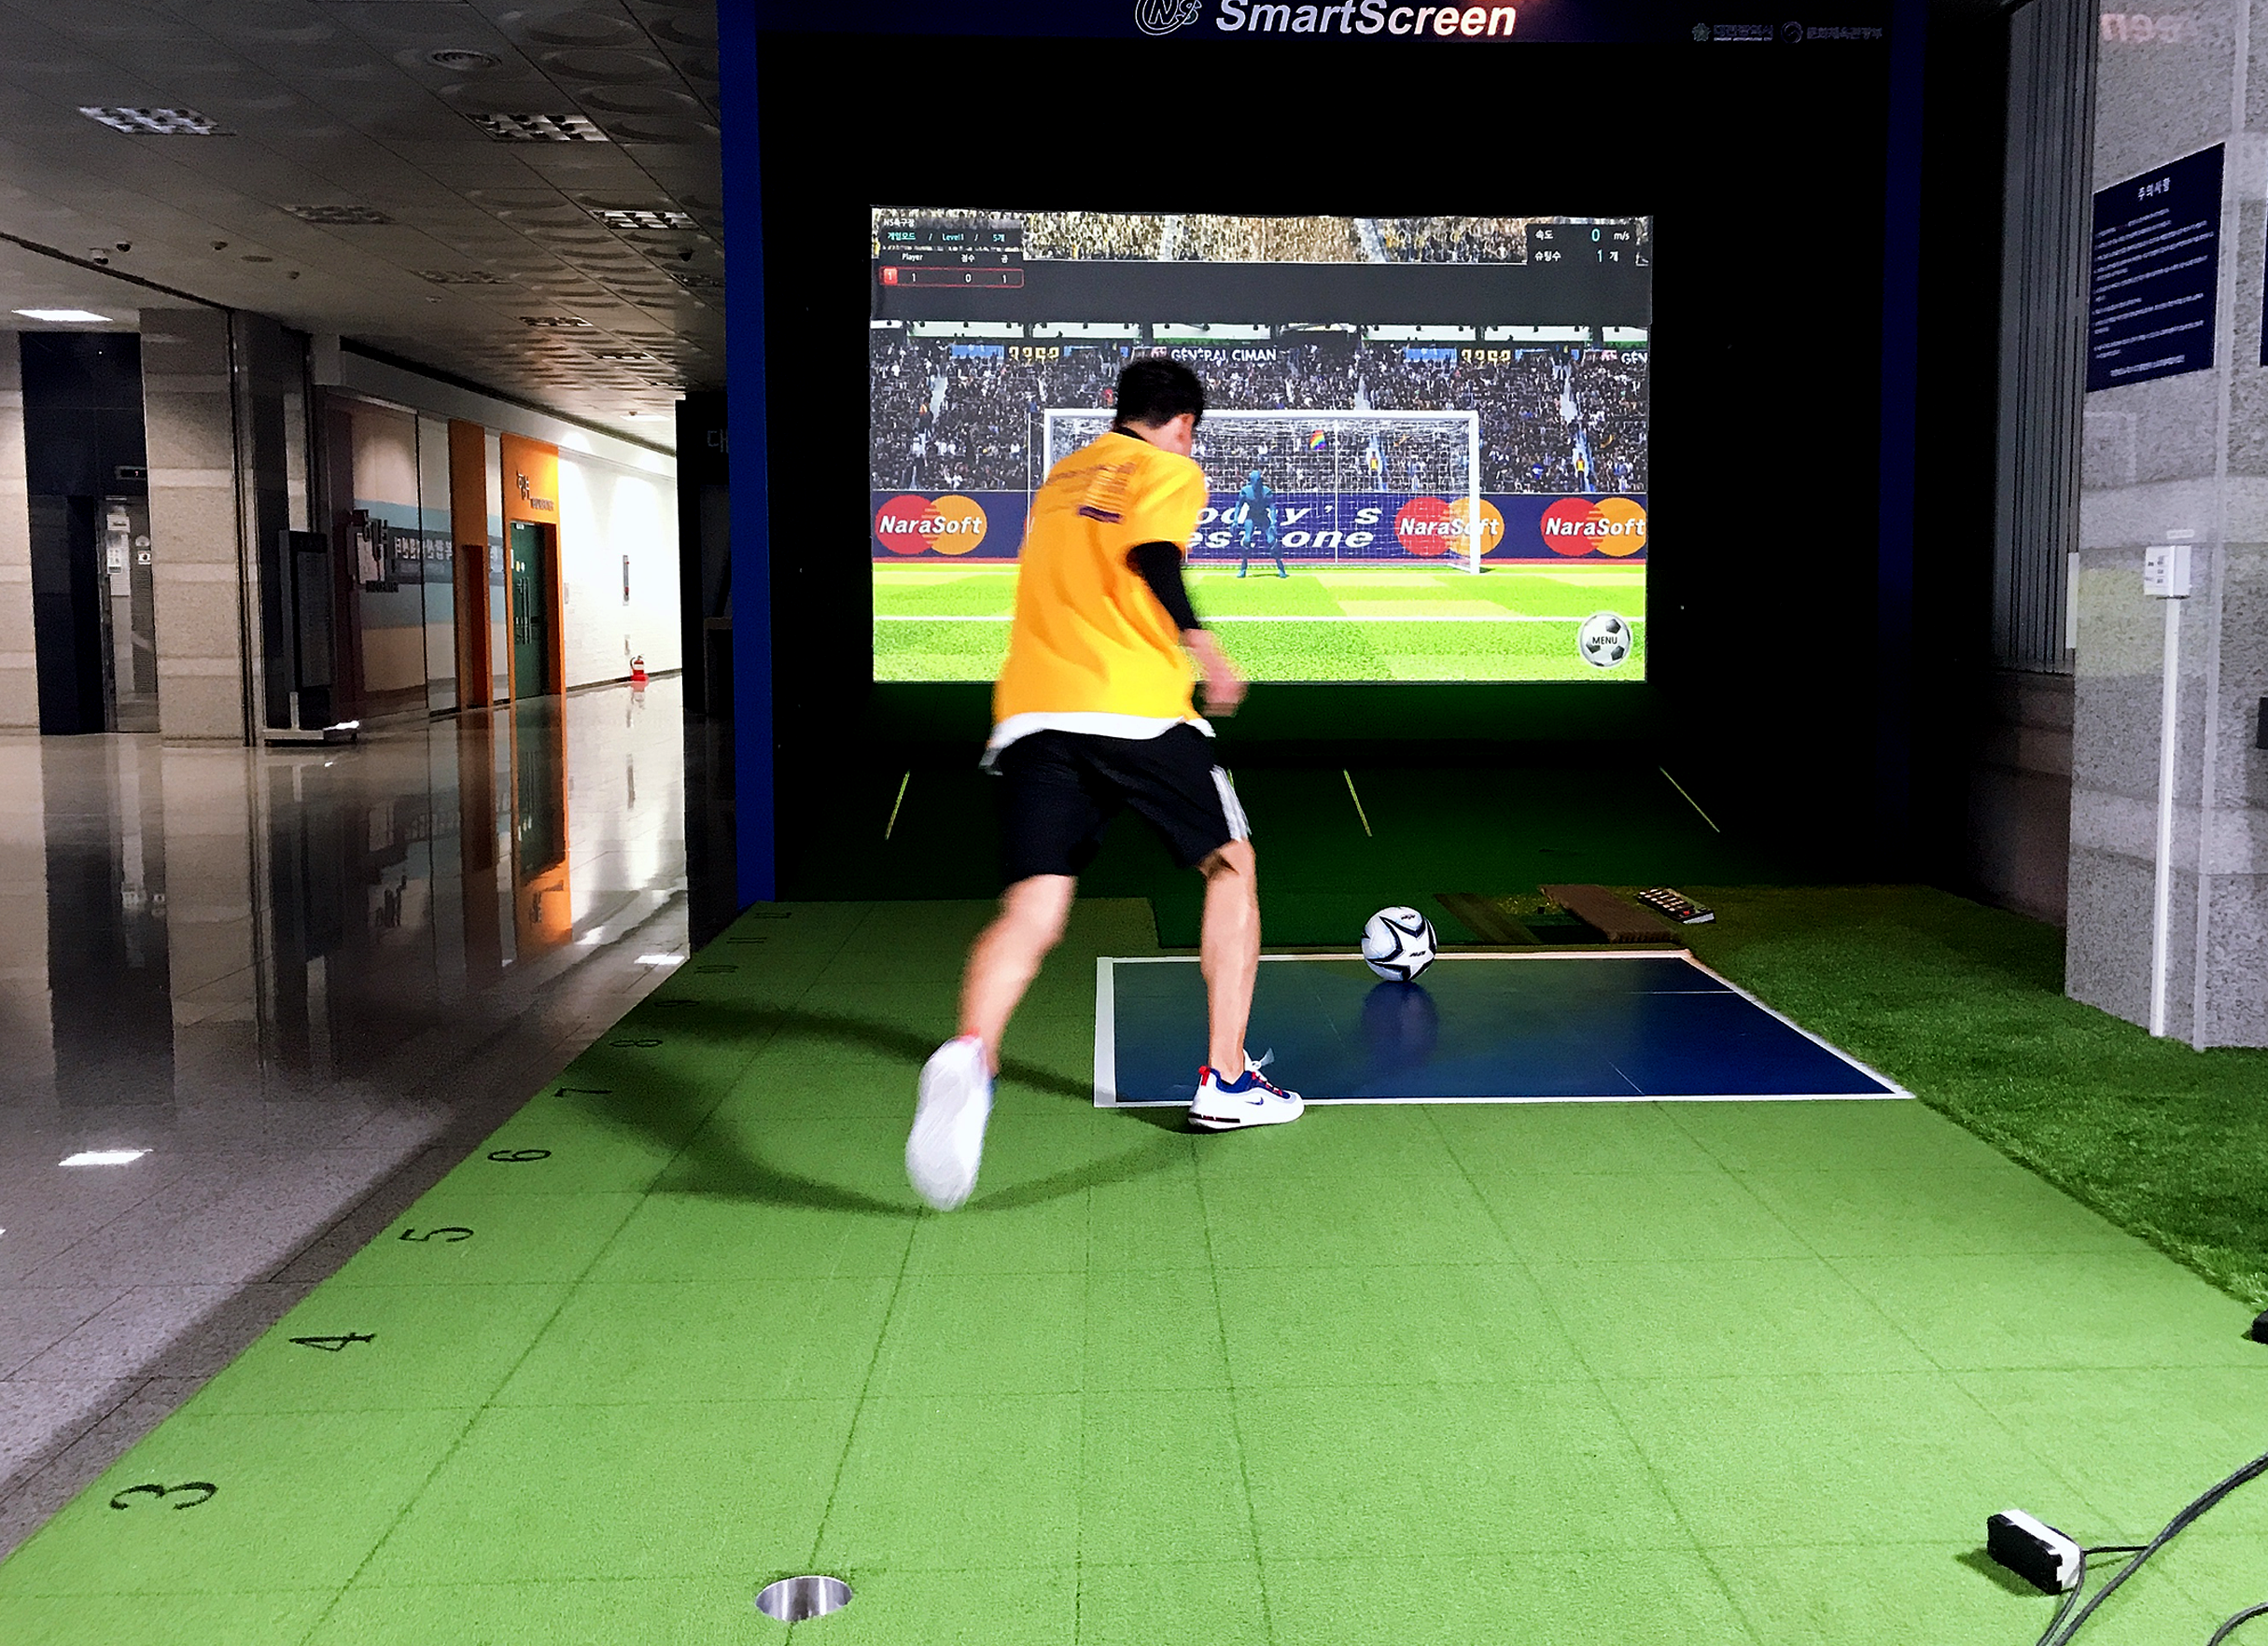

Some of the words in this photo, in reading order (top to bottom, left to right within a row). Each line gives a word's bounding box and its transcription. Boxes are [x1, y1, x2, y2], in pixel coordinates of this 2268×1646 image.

[1215, 0, 1517, 36] SmartScreen
[1591, 228, 1601, 242] 0
[1613, 230, 1630, 241] m/s
[902, 253, 923, 262] Player
[1597, 248, 1603, 262] 1
[878, 514, 983, 536] NaraSoft
[1545, 517, 1646, 537] NaraSoft
[1281, 530, 1375, 549] one
[1591, 635, 1618, 646] MENU
[609, 1039, 664, 1048] 8
[486, 1148, 553, 1163] 6
[398, 1225, 474, 1244] 5
[287, 1331, 377, 1353] 4
[109, 1480, 218, 1512] 3
